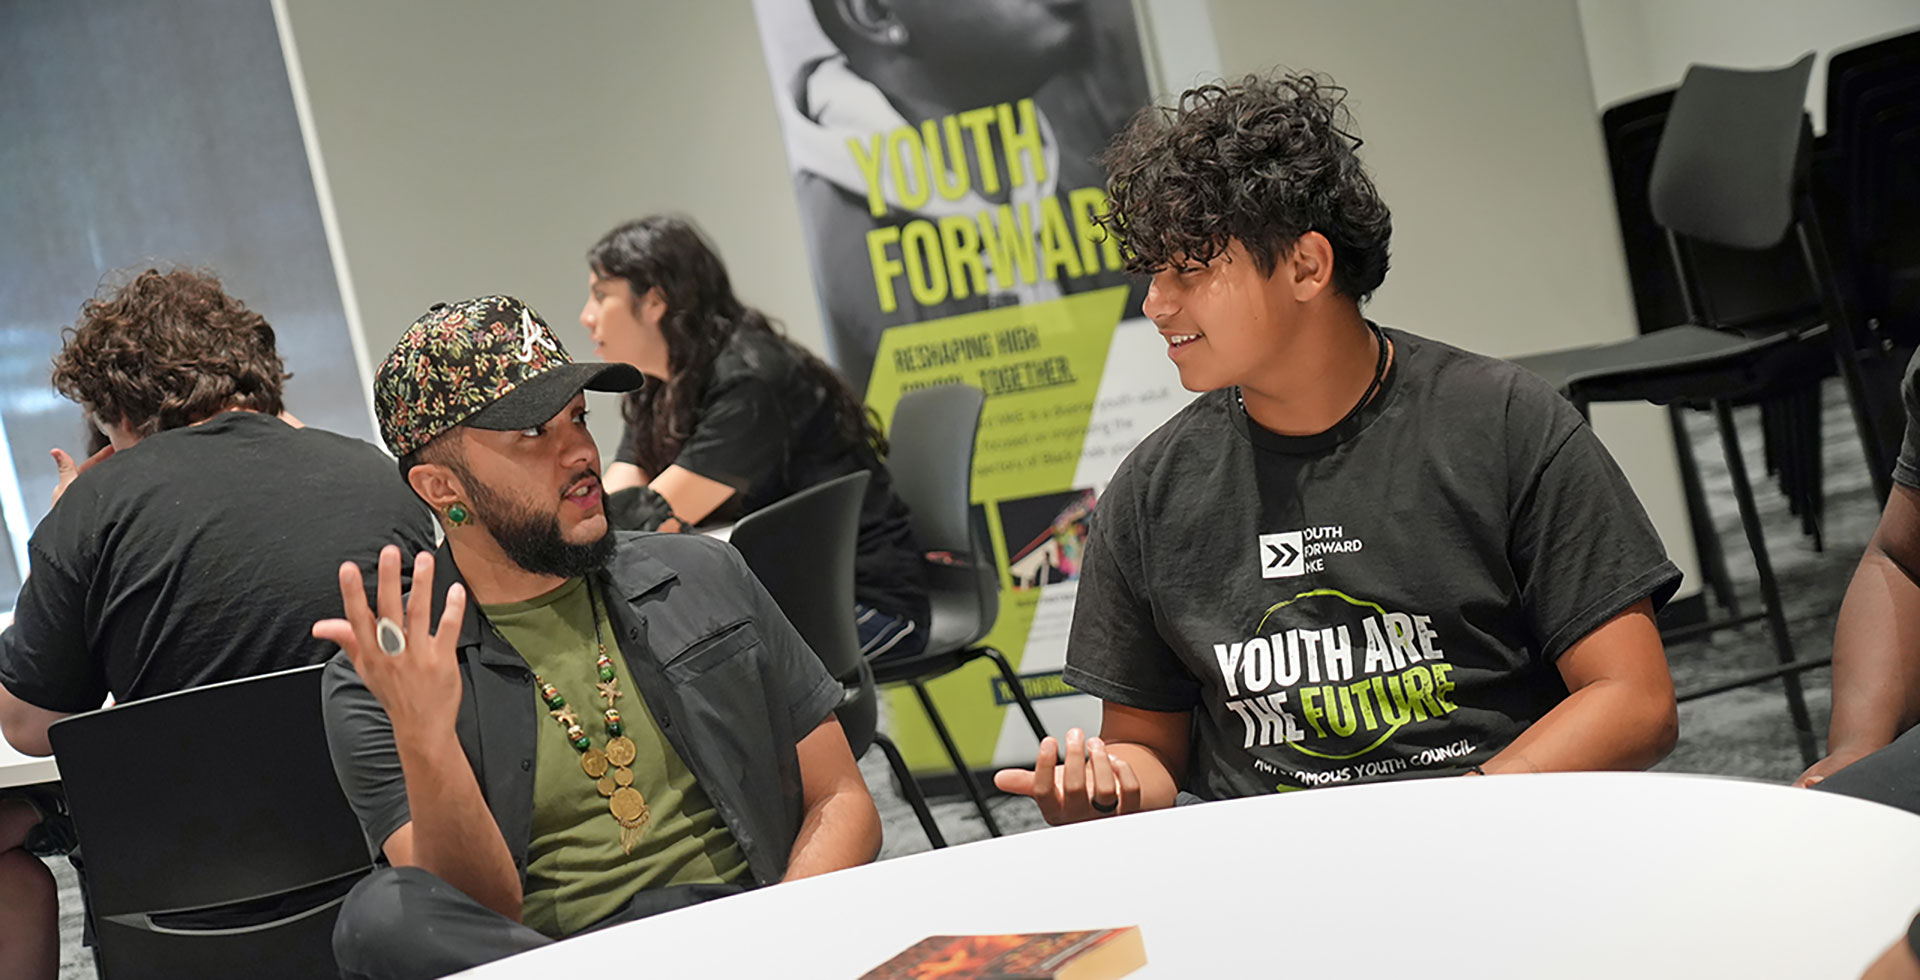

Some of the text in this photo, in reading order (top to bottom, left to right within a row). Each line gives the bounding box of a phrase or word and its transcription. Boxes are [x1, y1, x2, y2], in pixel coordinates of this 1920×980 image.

[846, 98, 1047, 219] YOUTH
[865, 187, 1124, 314] FORWAR
[893, 334, 992, 374] RESHAPING
[1213, 611, 1444, 697] YOUTH ARE
[1226, 663, 1459, 749] THE FUTURE
[1354, 758, 1407, 778] YOUTH
[1409, 739, 1477, 766] COUNCIL
